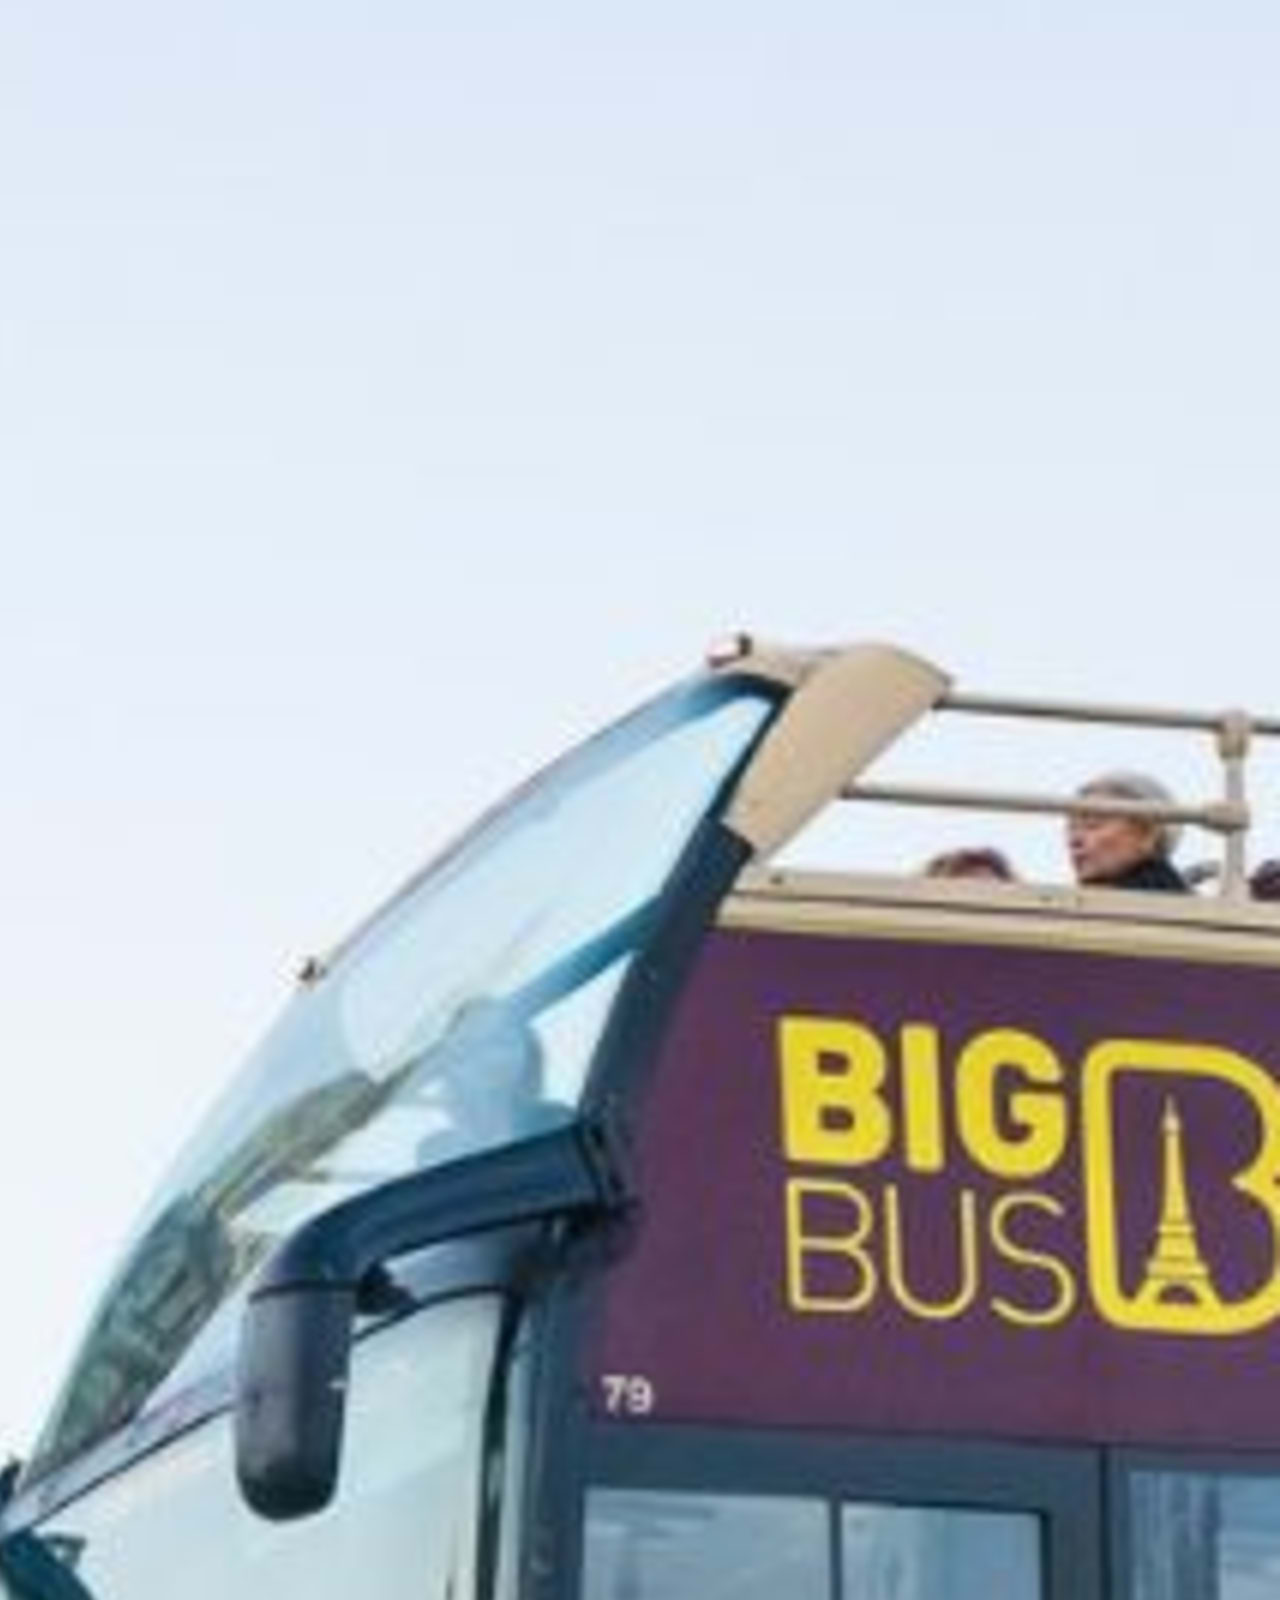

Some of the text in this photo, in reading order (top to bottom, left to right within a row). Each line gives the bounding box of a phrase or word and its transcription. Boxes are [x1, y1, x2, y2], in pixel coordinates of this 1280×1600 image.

[778, 1016, 1068, 1179] BIG
[785, 1177, 1076, 1325] BUS
[601, 1373, 653, 1414] 79
